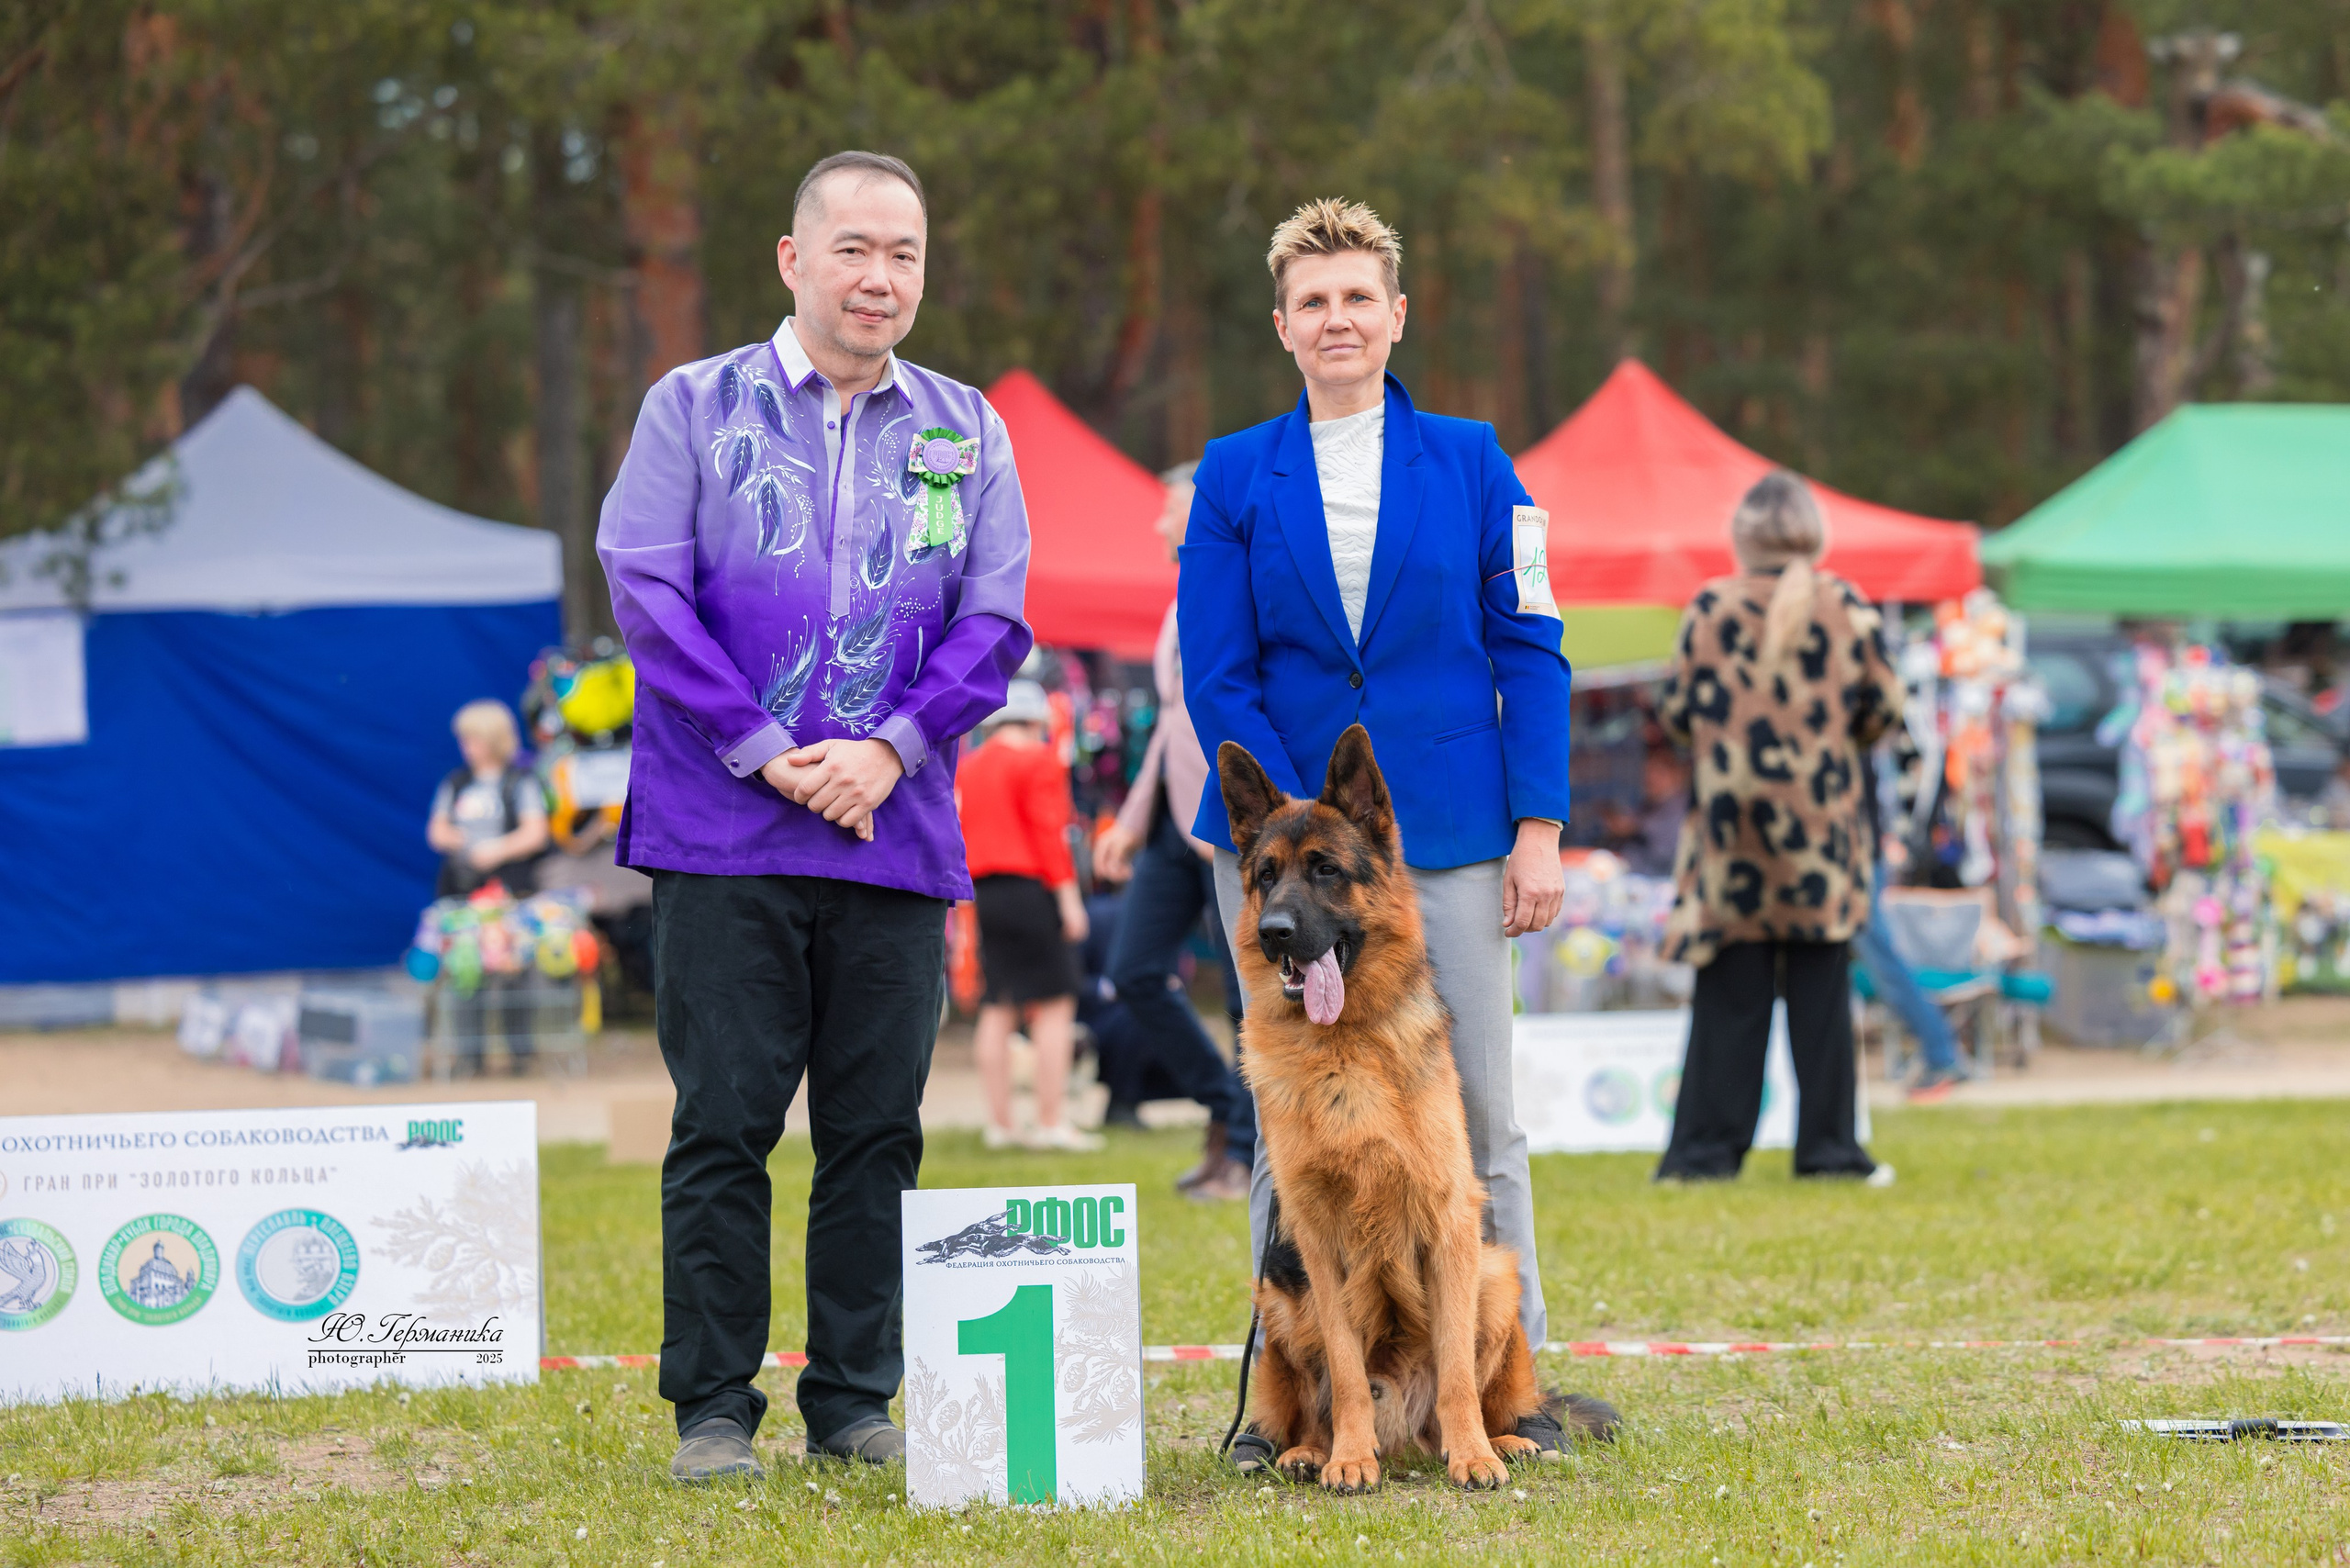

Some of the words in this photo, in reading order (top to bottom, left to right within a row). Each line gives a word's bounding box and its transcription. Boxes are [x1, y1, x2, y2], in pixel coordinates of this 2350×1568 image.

[934, 496, 945, 534] JUDGE
[1516, 514, 1546, 527] GRANDO
[1523, 546, 1548, 588] 12
[2, 1131, 176, 1153] ОХОТНИЧЬЕГО
[184, 1126, 389, 1148] СОБАКОВОДСТВА
[24, 1174, 70, 1192] ГРАН
[83, 1172, 118, 1191] ПРИ
[129, 1170, 240, 1189] "ЗОЛОТОГО
[251, 1166, 338, 1185] КОЛЬЦА"
[119, 1217, 152, 1242] КУБОК
[1006, 1196, 1125, 1249] РФОС
[946, 1260, 994, 1269] ФЕДЕРАЦИЯ
[996, 1259, 1055, 1268] ОХОТНИЧЬЕГО
[1057, 1257, 1125, 1266] СОБАКОВОДСТВА
[957, 1284, 1058, 1506] 1
